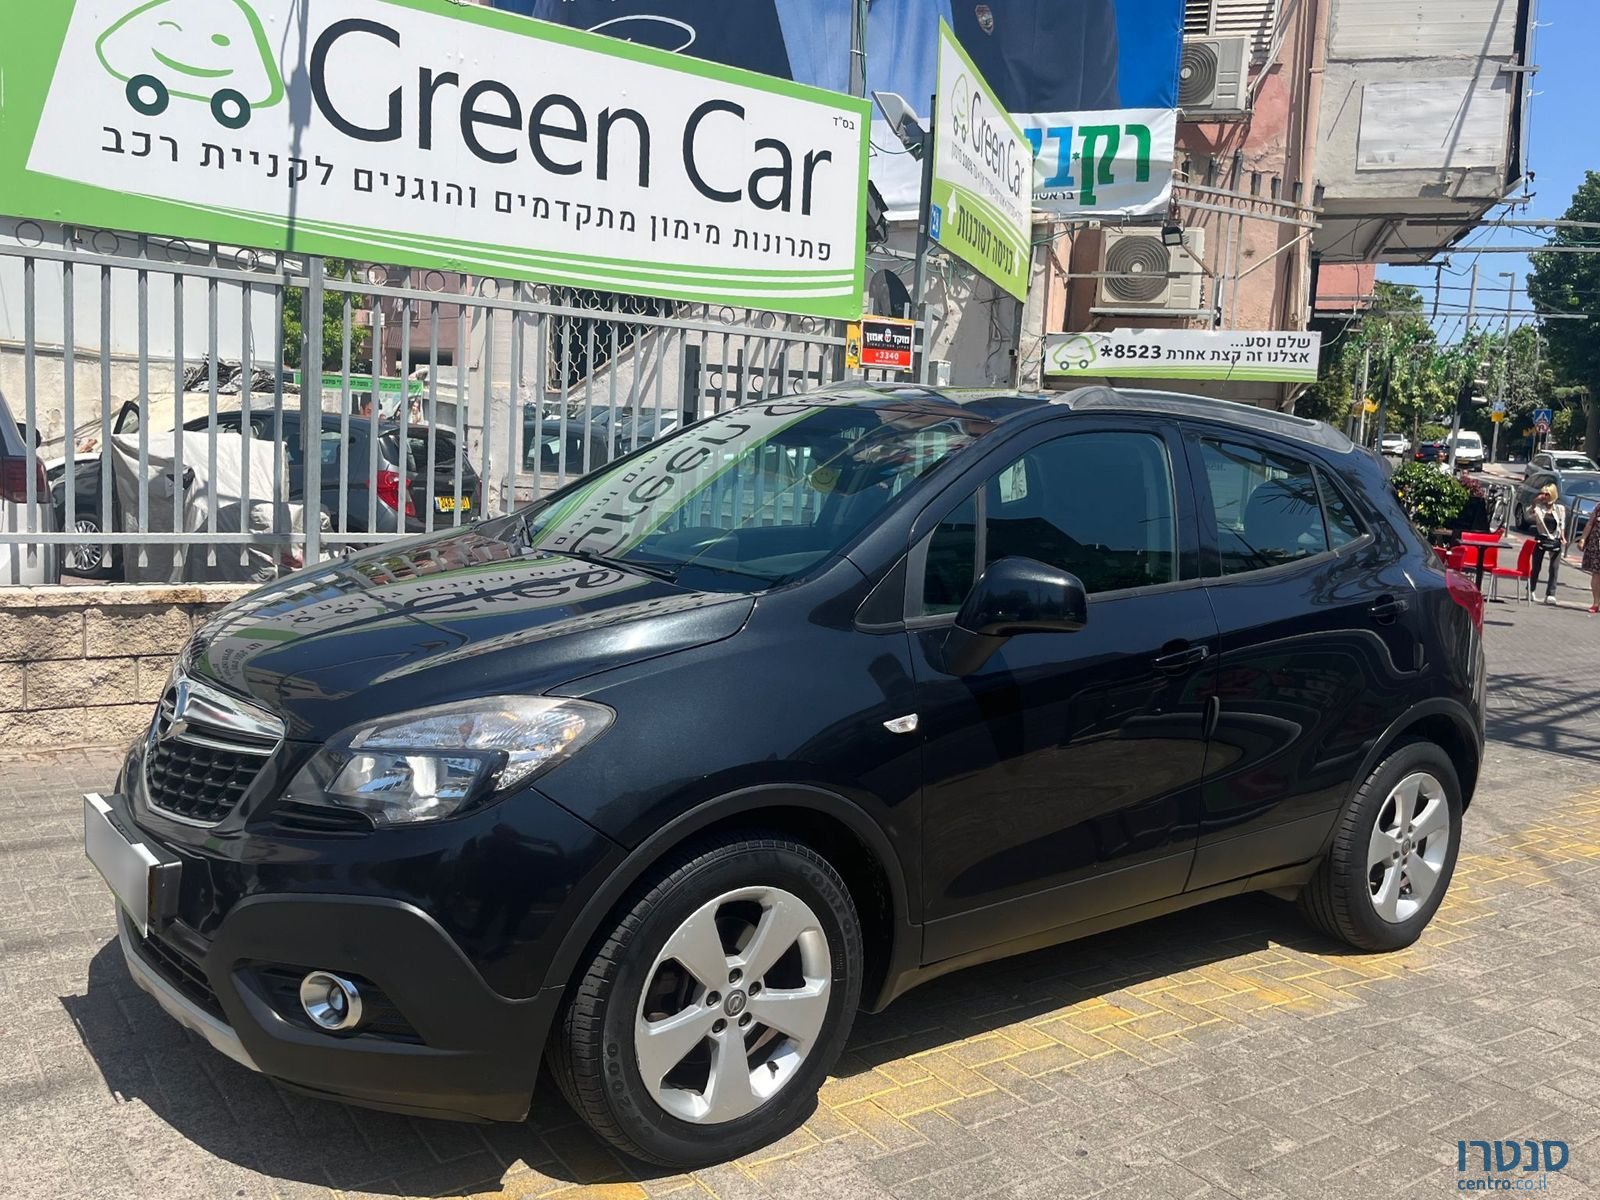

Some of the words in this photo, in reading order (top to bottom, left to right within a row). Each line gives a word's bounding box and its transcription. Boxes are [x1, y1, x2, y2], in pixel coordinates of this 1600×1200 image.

[310, 18, 652, 188] Green
[682, 99, 832, 216] Car
[832, 116, 855, 130] בס"ד
[101, 126, 178, 163] רכב
[971, 91, 1005, 182] Green
[1007, 139, 1025, 198] Car
[199, 142, 334, 189] לקניית
[354, 168, 477, 209] והוגנים
[495, 190, 635, 232] מתקדמים
[650, 215, 721, 243] מימון
[732, 229, 831, 262] פתרונות
[992, 235, 1013, 275] כניסה
[892, 334, 910, 345] מוקד
[1230, 337, 1272, 348] וסע...
[1276, 335, 1311, 349] שלם
[1165, 349, 1206, 361] אחרת
[1209, 350, 1241, 364] קצת
[1246, 351, 1263, 362] זה
[1267, 350, 1310, 363] אצלנו
